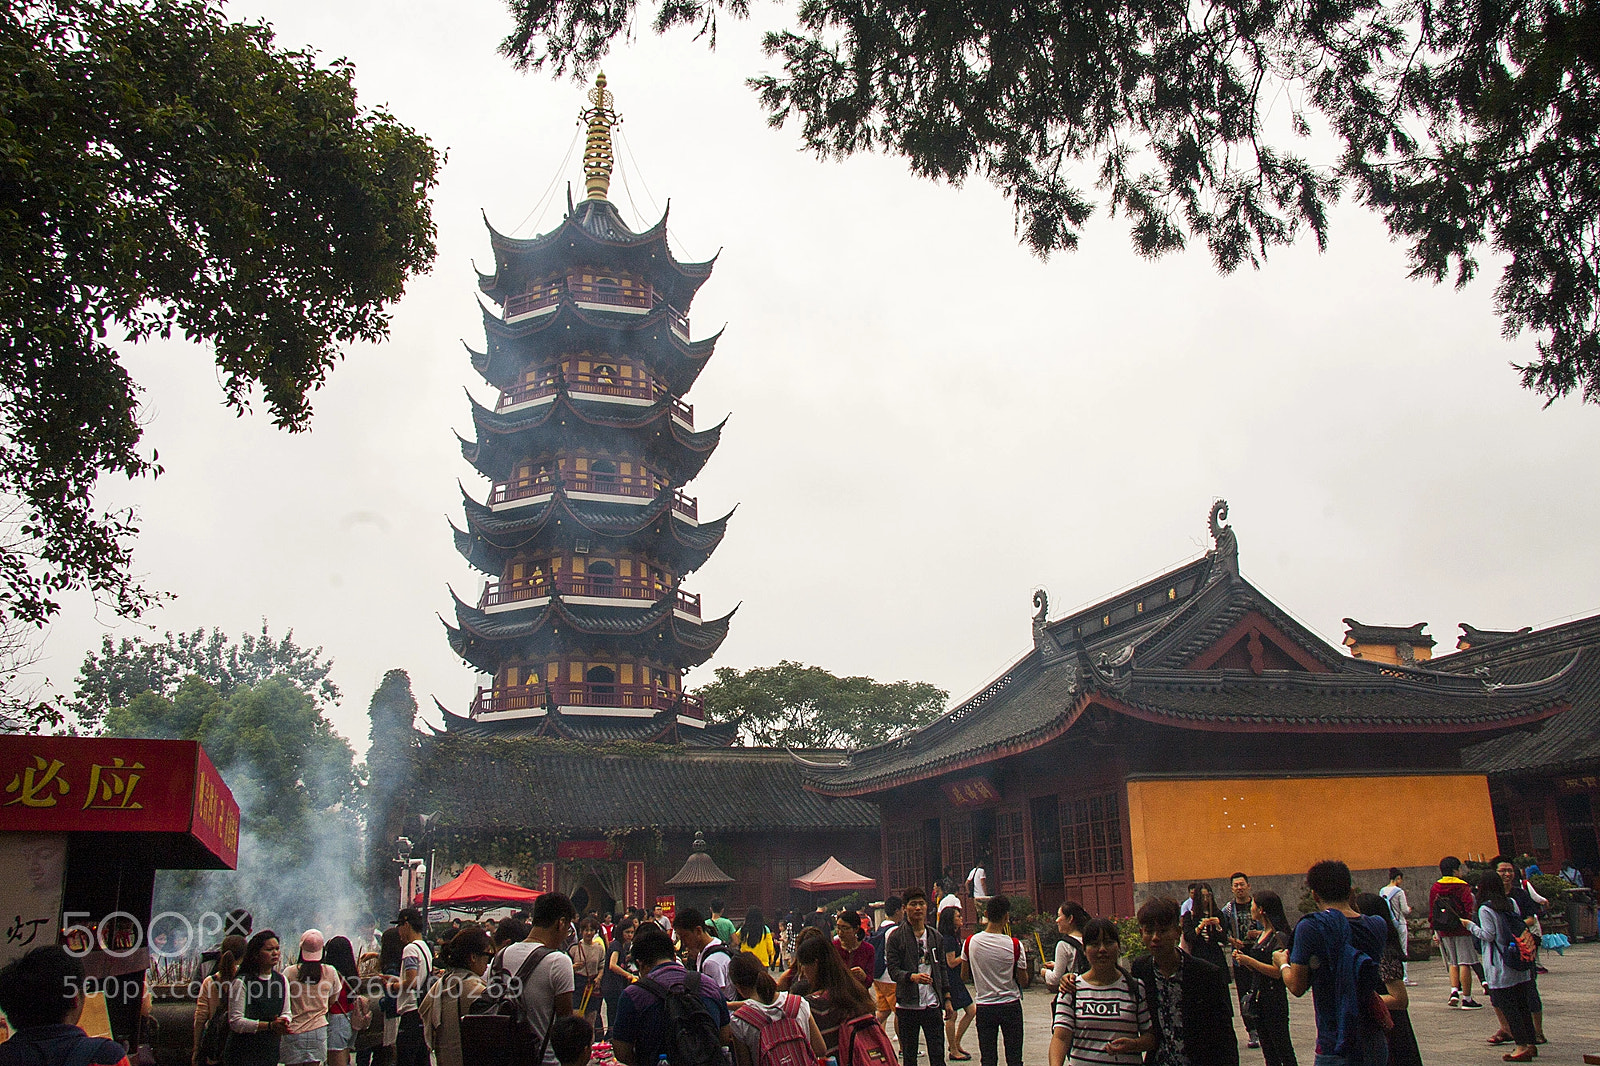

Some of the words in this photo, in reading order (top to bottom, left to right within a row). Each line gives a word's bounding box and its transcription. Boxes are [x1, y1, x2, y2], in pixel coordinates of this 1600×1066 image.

[3, 755, 146, 810] 必应
[7, 915, 50, 947] 灯
[1085, 1003, 1118, 1015] NO.1
